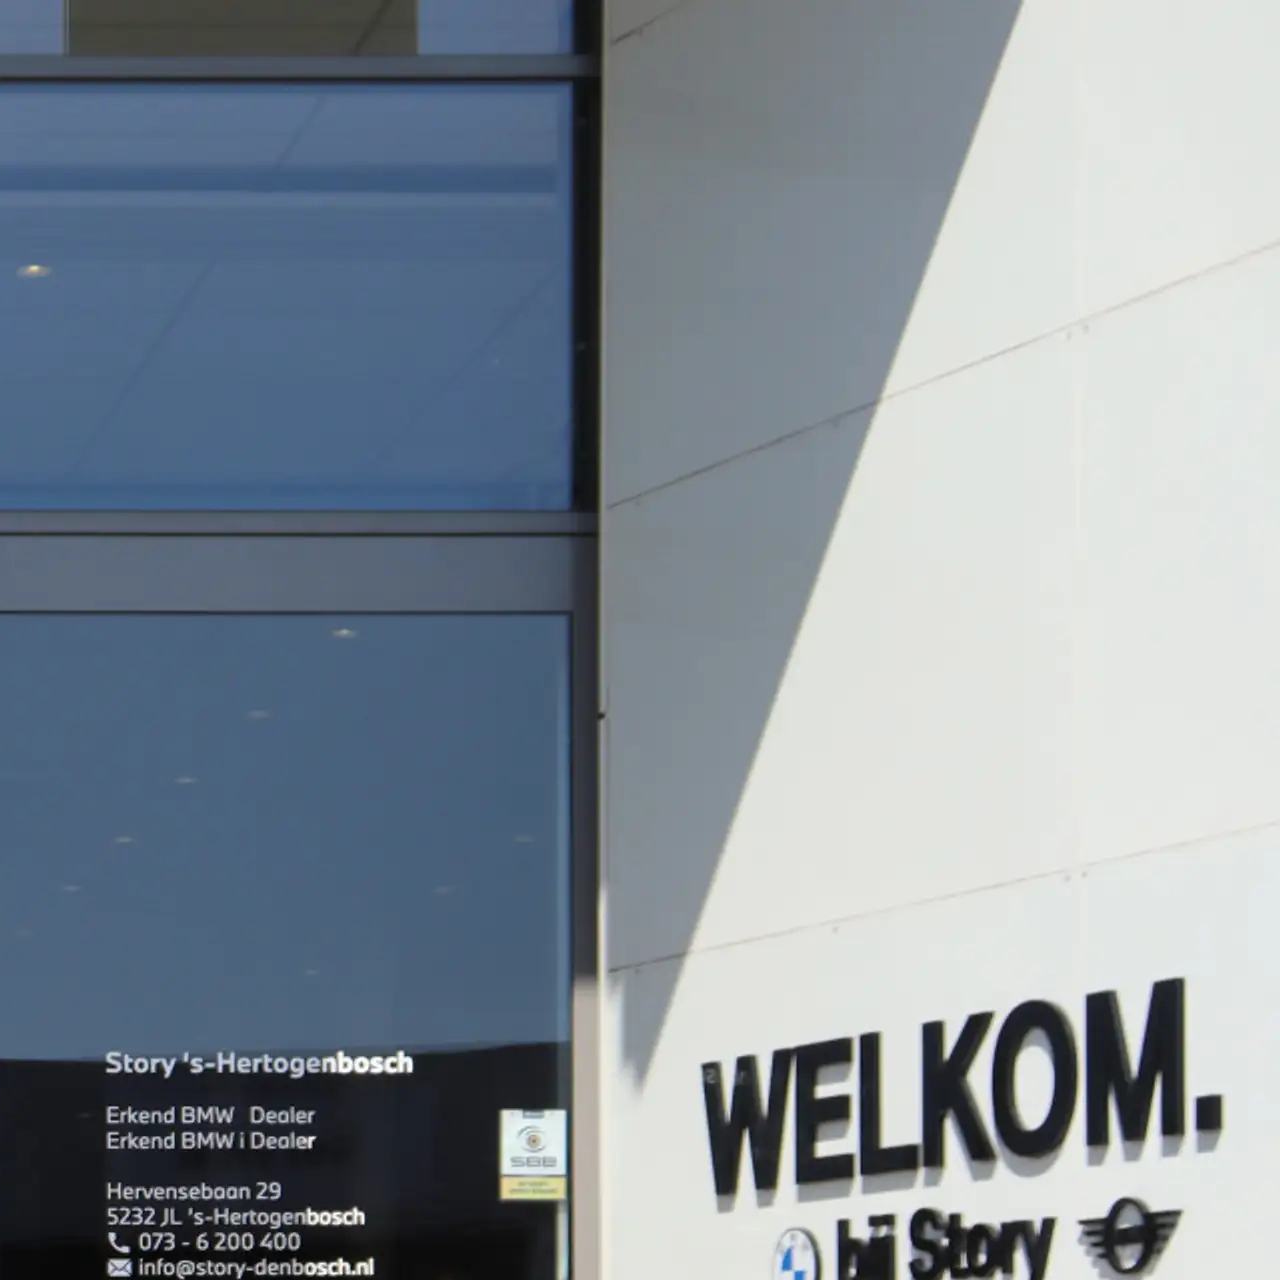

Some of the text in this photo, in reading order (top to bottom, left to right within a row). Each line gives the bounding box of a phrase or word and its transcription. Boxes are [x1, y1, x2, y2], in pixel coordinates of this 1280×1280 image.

[105, 1050, 414, 1079] Story 's-Hertogenbosch
[700, 977, 1224, 1196] WELKOM.
[106, 1106, 316, 1124] Erkend BMW Dealer
[106, 1131, 317, 1150] Erkend BMW i Dealer
[107, 1182, 282, 1201] Hervensebaan 29
[107, 1206, 366, 1228] 5232 JL 's-Hertogenbosch
[139, 1232, 176, 1251] 073
[196, 1232, 210, 1251] 6
[214, 1232, 255, 1251] 200
[260, 1232, 301, 1251] 400
[139, 1257, 375, 1280] info@story-denbosch.nl
